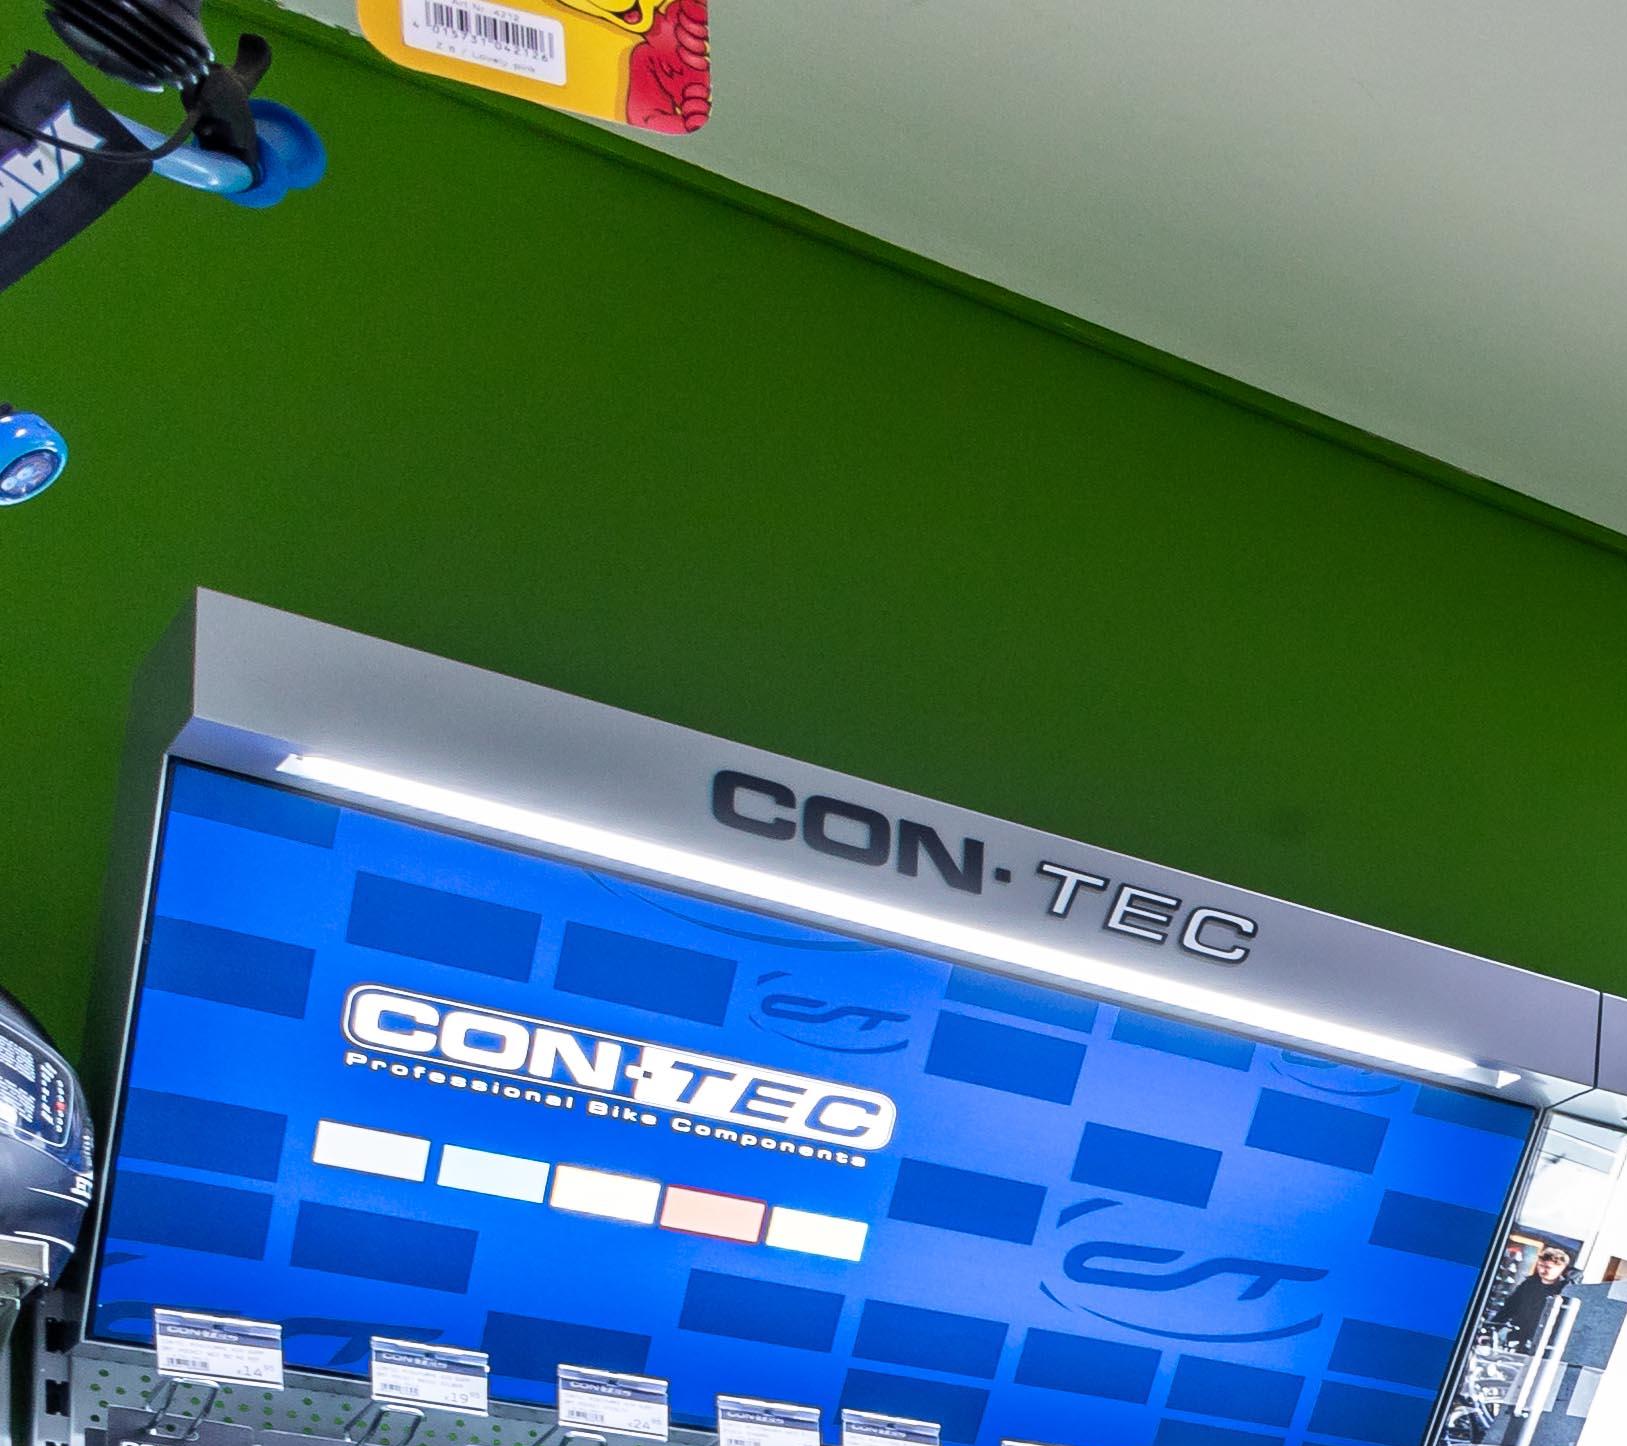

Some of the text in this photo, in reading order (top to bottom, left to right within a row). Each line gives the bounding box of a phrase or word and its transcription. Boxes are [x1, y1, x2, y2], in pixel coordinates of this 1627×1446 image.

[345, 1051, 865, 1168] Professional Bike Components
